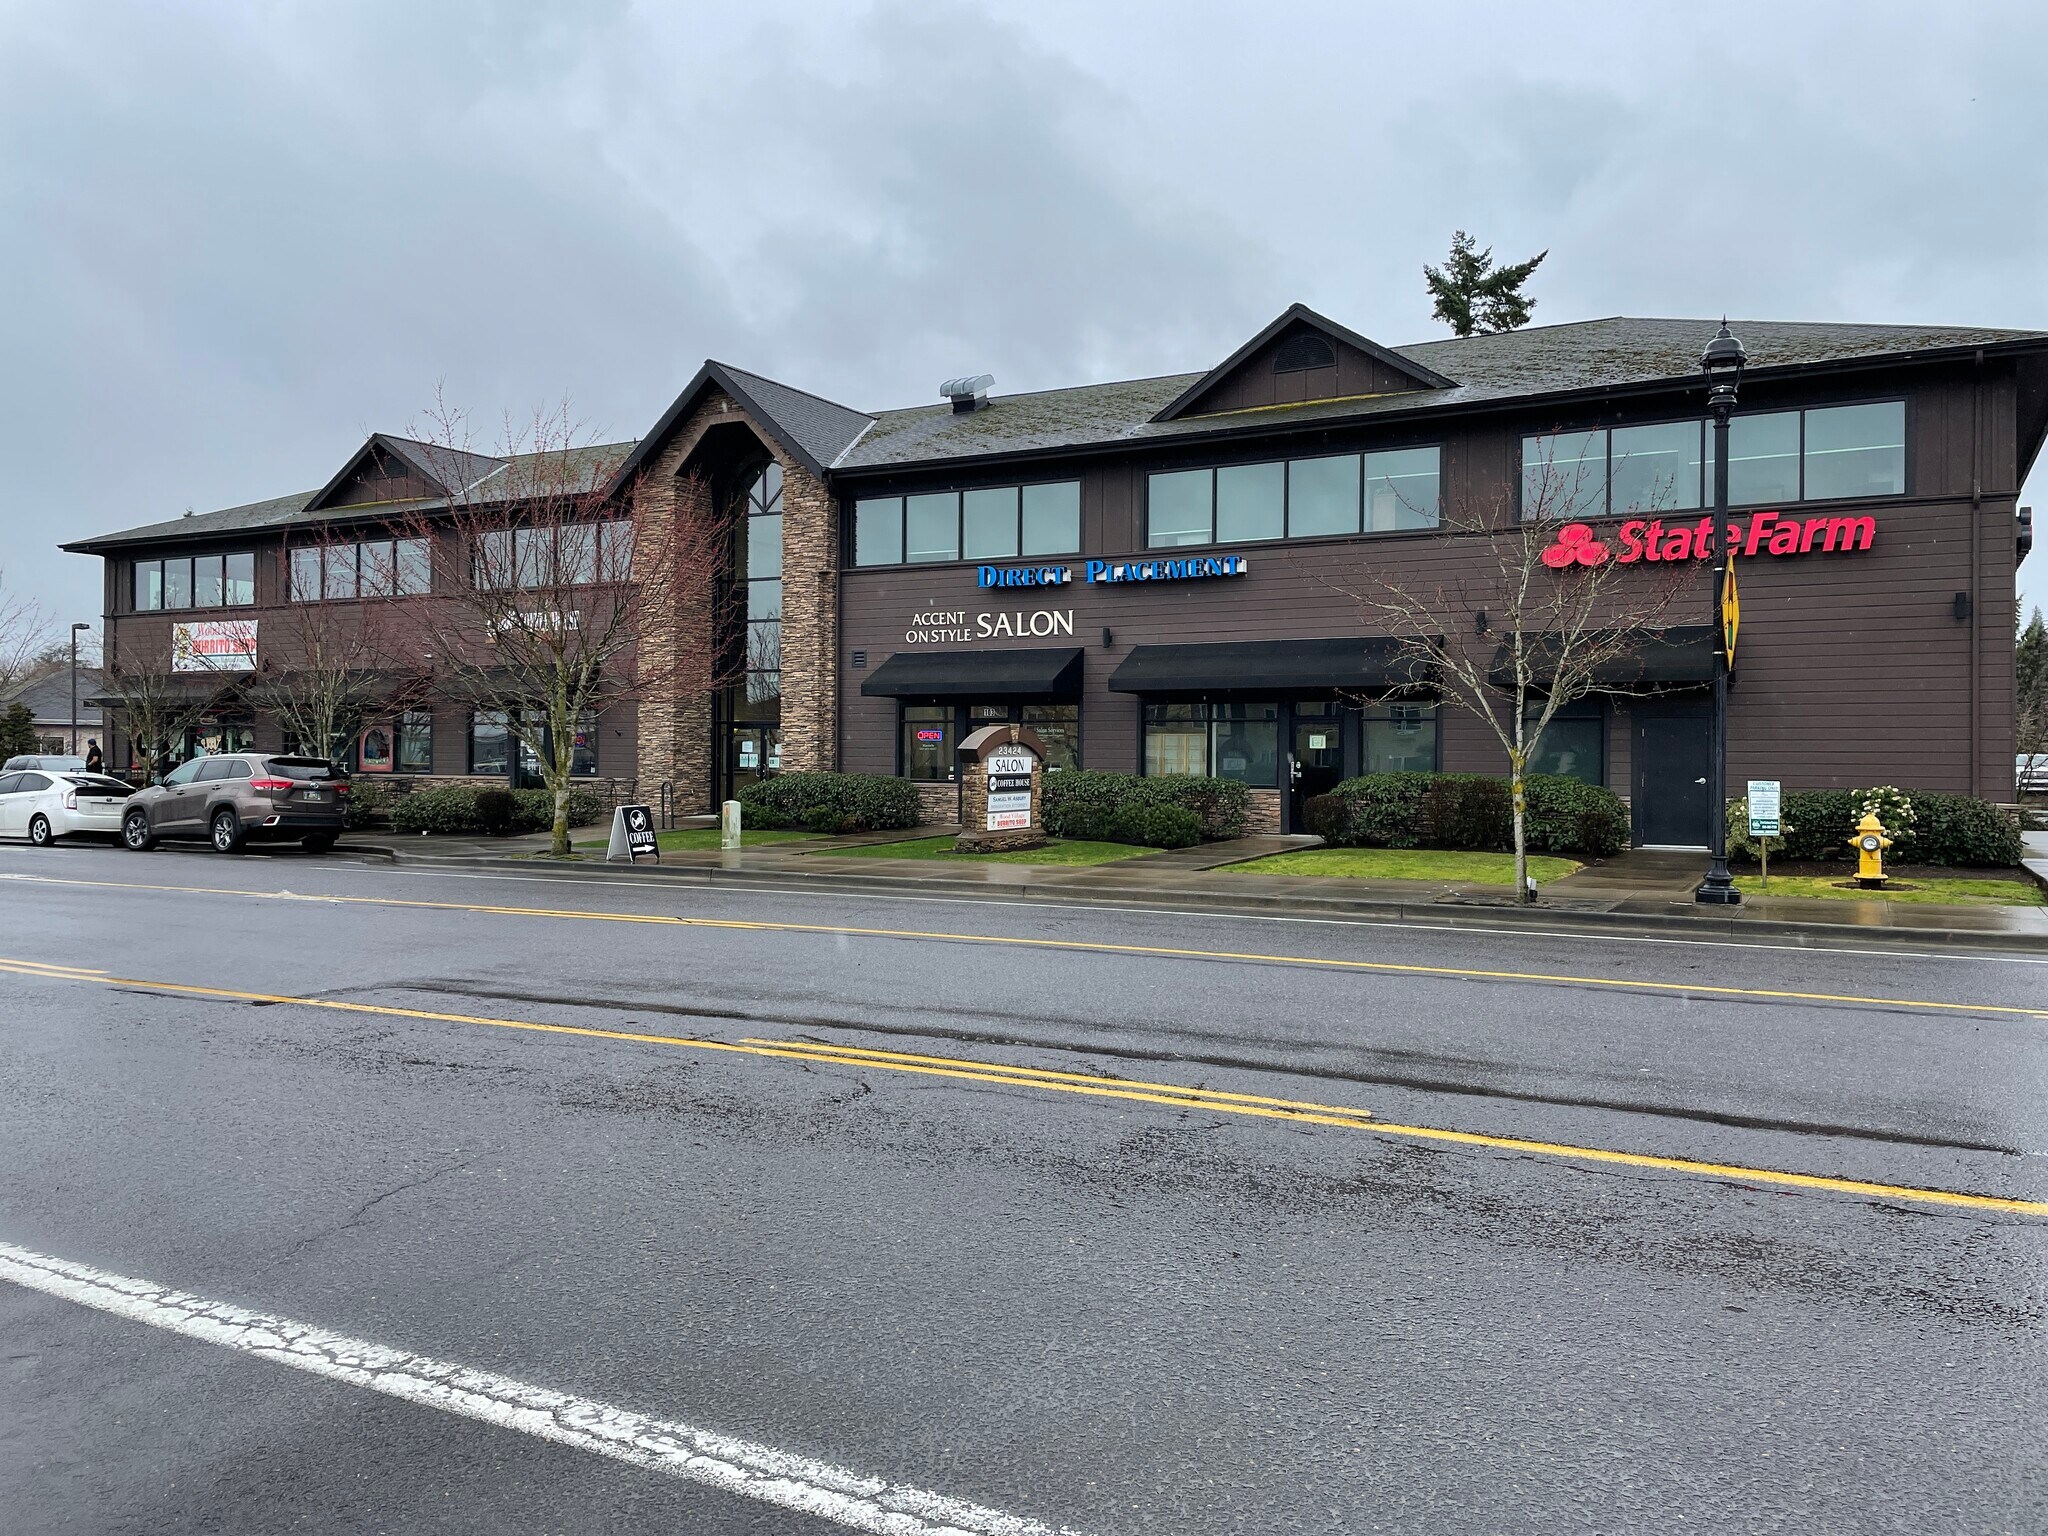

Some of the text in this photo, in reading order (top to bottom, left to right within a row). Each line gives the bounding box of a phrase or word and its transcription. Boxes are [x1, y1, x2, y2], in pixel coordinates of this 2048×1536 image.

[977, 556, 1245, 589] DIRECT PLACEMENT
[912, 611, 966, 626] ACCENT
[976, 610, 1074, 638] SALON
[905, 628, 972, 643] ON STYLE
[917, 731, 941, 740] OPEN
[998, 746, 1022, 755] 23424
[995, 759, 1025, 772] SALON
[997, 778, 1031, 788] COFFEE HOUSE
[629, 831, 655, 844] COFFEE
